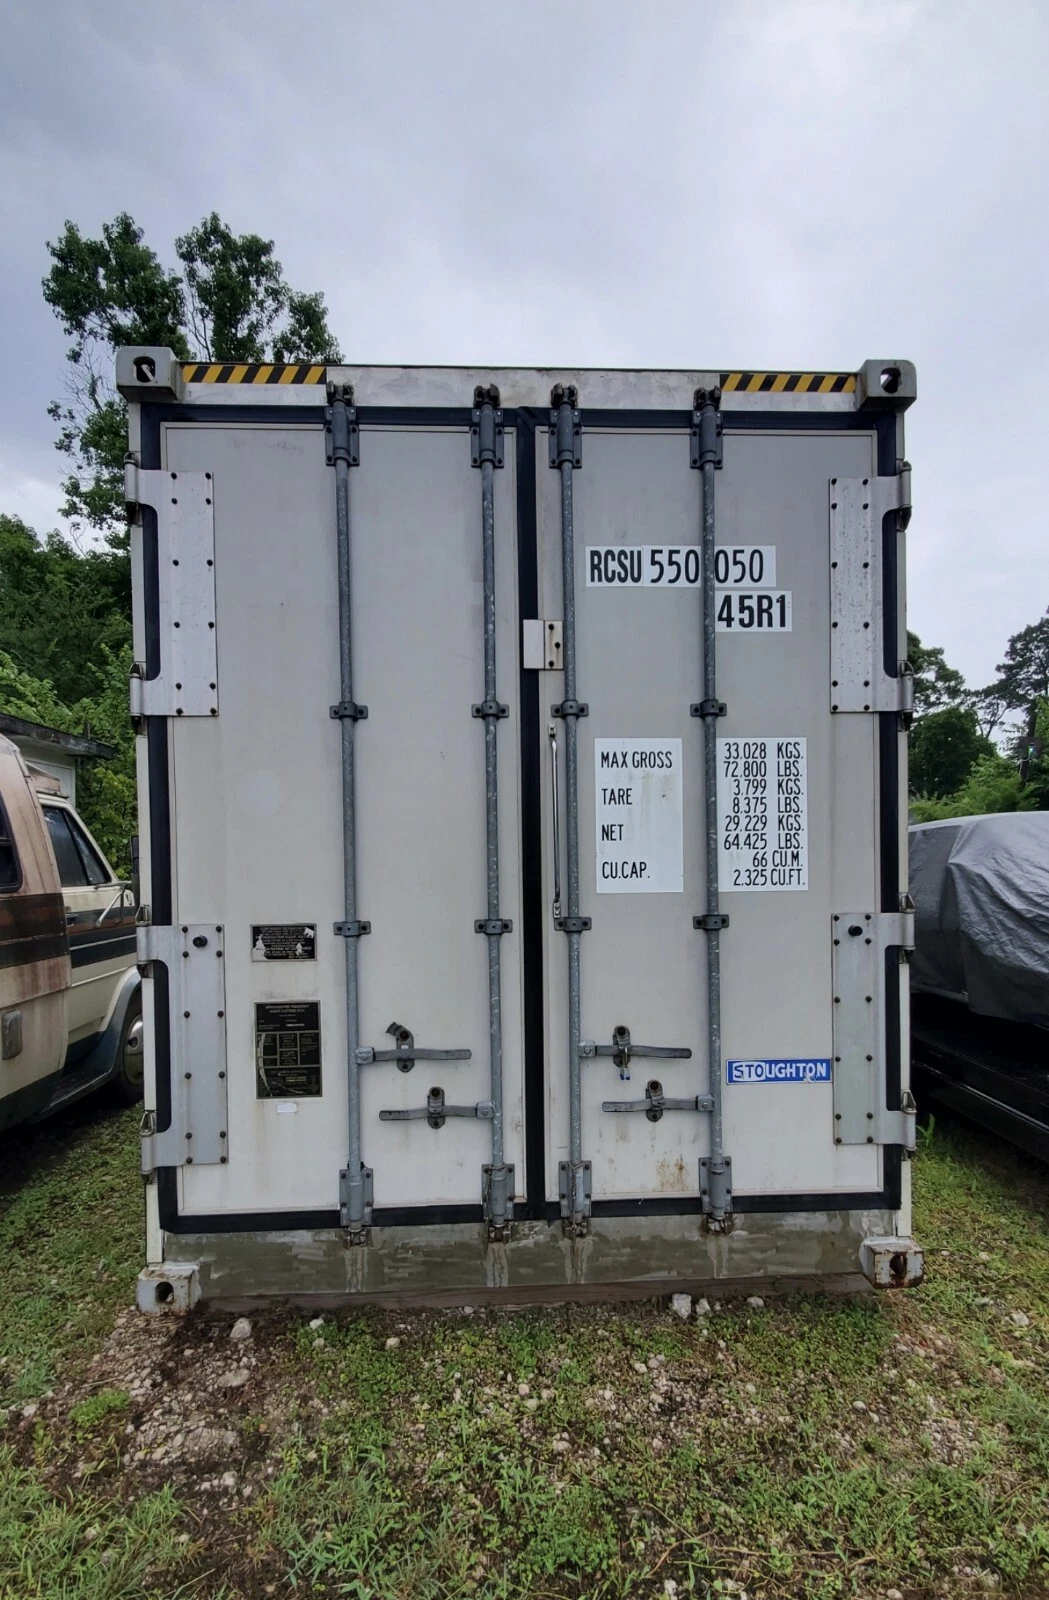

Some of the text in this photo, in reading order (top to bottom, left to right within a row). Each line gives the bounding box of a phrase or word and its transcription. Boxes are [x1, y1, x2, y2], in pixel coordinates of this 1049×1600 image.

[590, 549, 642, 583] RCSU
[717, 594, 786, 628] 45R1
[601, 751, 673, 769] MAX GROSS
[724, 742, 804, 760] 33,028 KGS.
[723, 760, 803, 778] 72,800 LBS.
[733, 778, 804, 796] 3,799 KGS.
[602, 788, 633, 805] TARE
[733, 796, 803, 814] 8,375 LBS.
[725, 814, 804, 832] 29,229 KGS.
[601, 824, 624, 841] NET
[724, 832, 804, 850] 64,425 LBS.
[752, 850, 803, 867] 66 CU.M.
[602, 861, 650, 879] CU.CAP.
[733, 868, 806, 886] 2,325 CU.FT.
[734, 1062, 827, 1079] STOUGHTON
